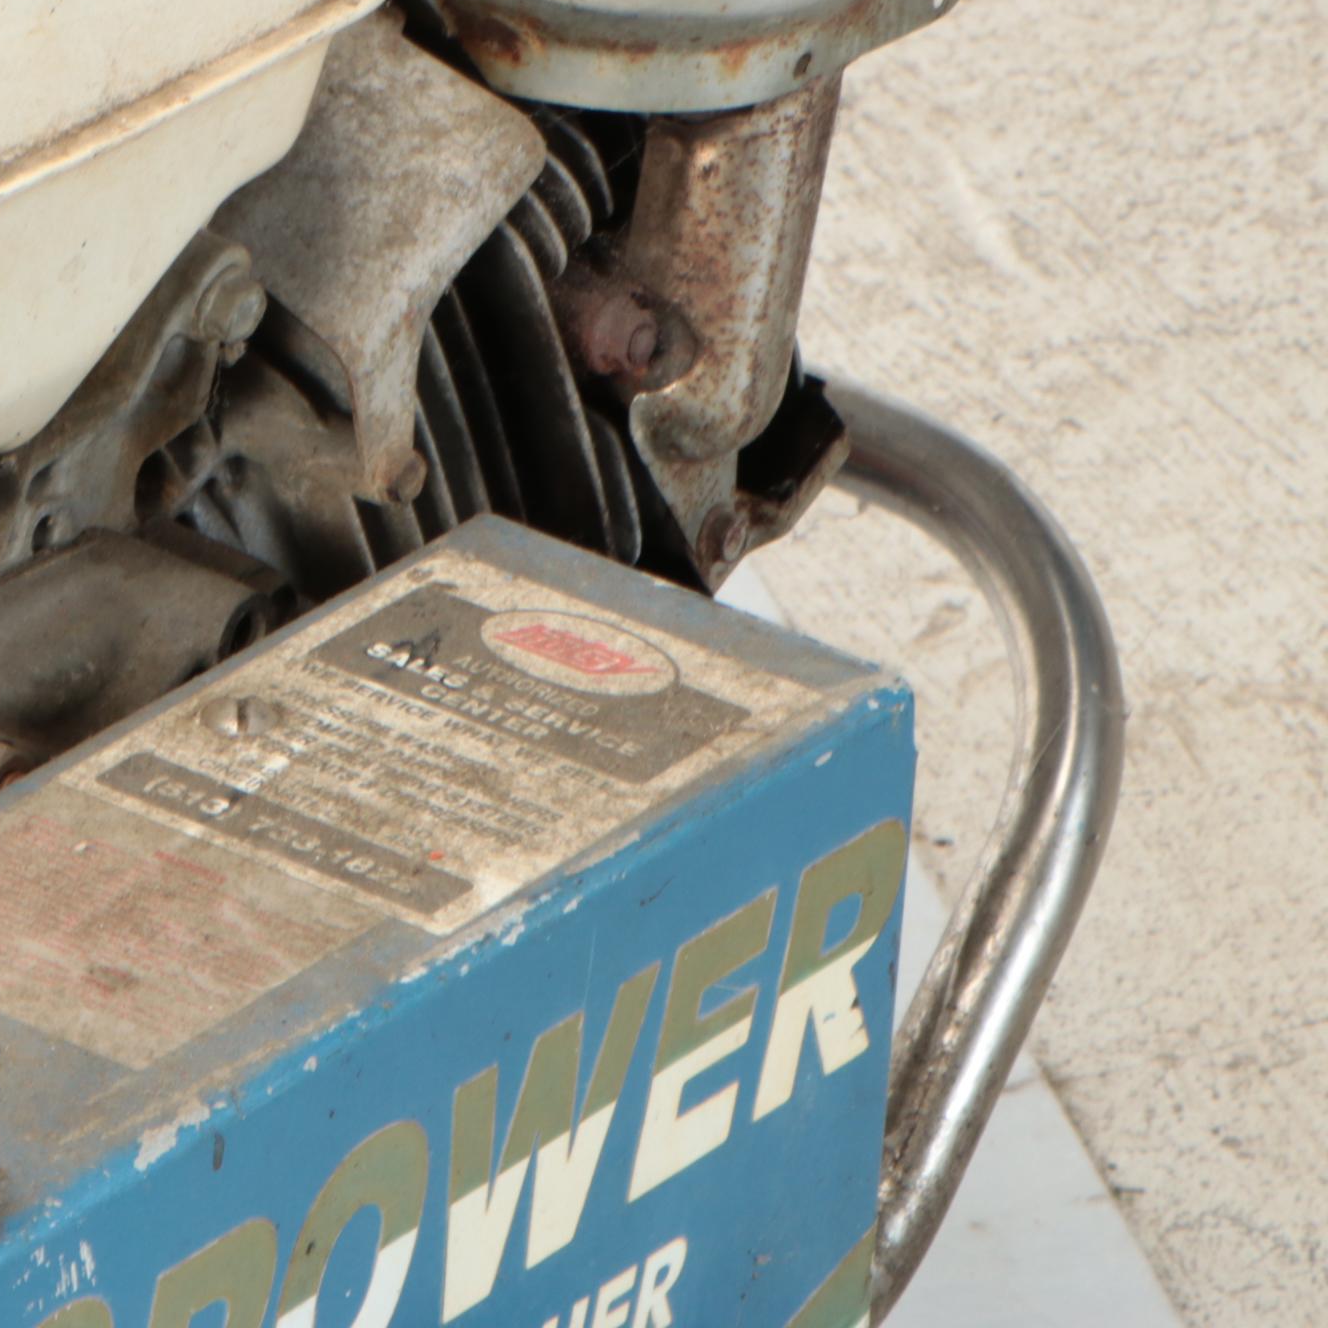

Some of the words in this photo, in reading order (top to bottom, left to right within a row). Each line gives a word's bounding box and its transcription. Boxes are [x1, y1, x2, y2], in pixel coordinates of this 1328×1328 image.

[335, 676, 443, 722] SERVICE
[436, 716, 511, 750] WHAT
[358, 640, 477, 692] SALES
[497, 694, 647, 760] SERVICE
[413, 681, 553, 742] CENTER
[446, 651, 606, 721] AUTHORIZED
